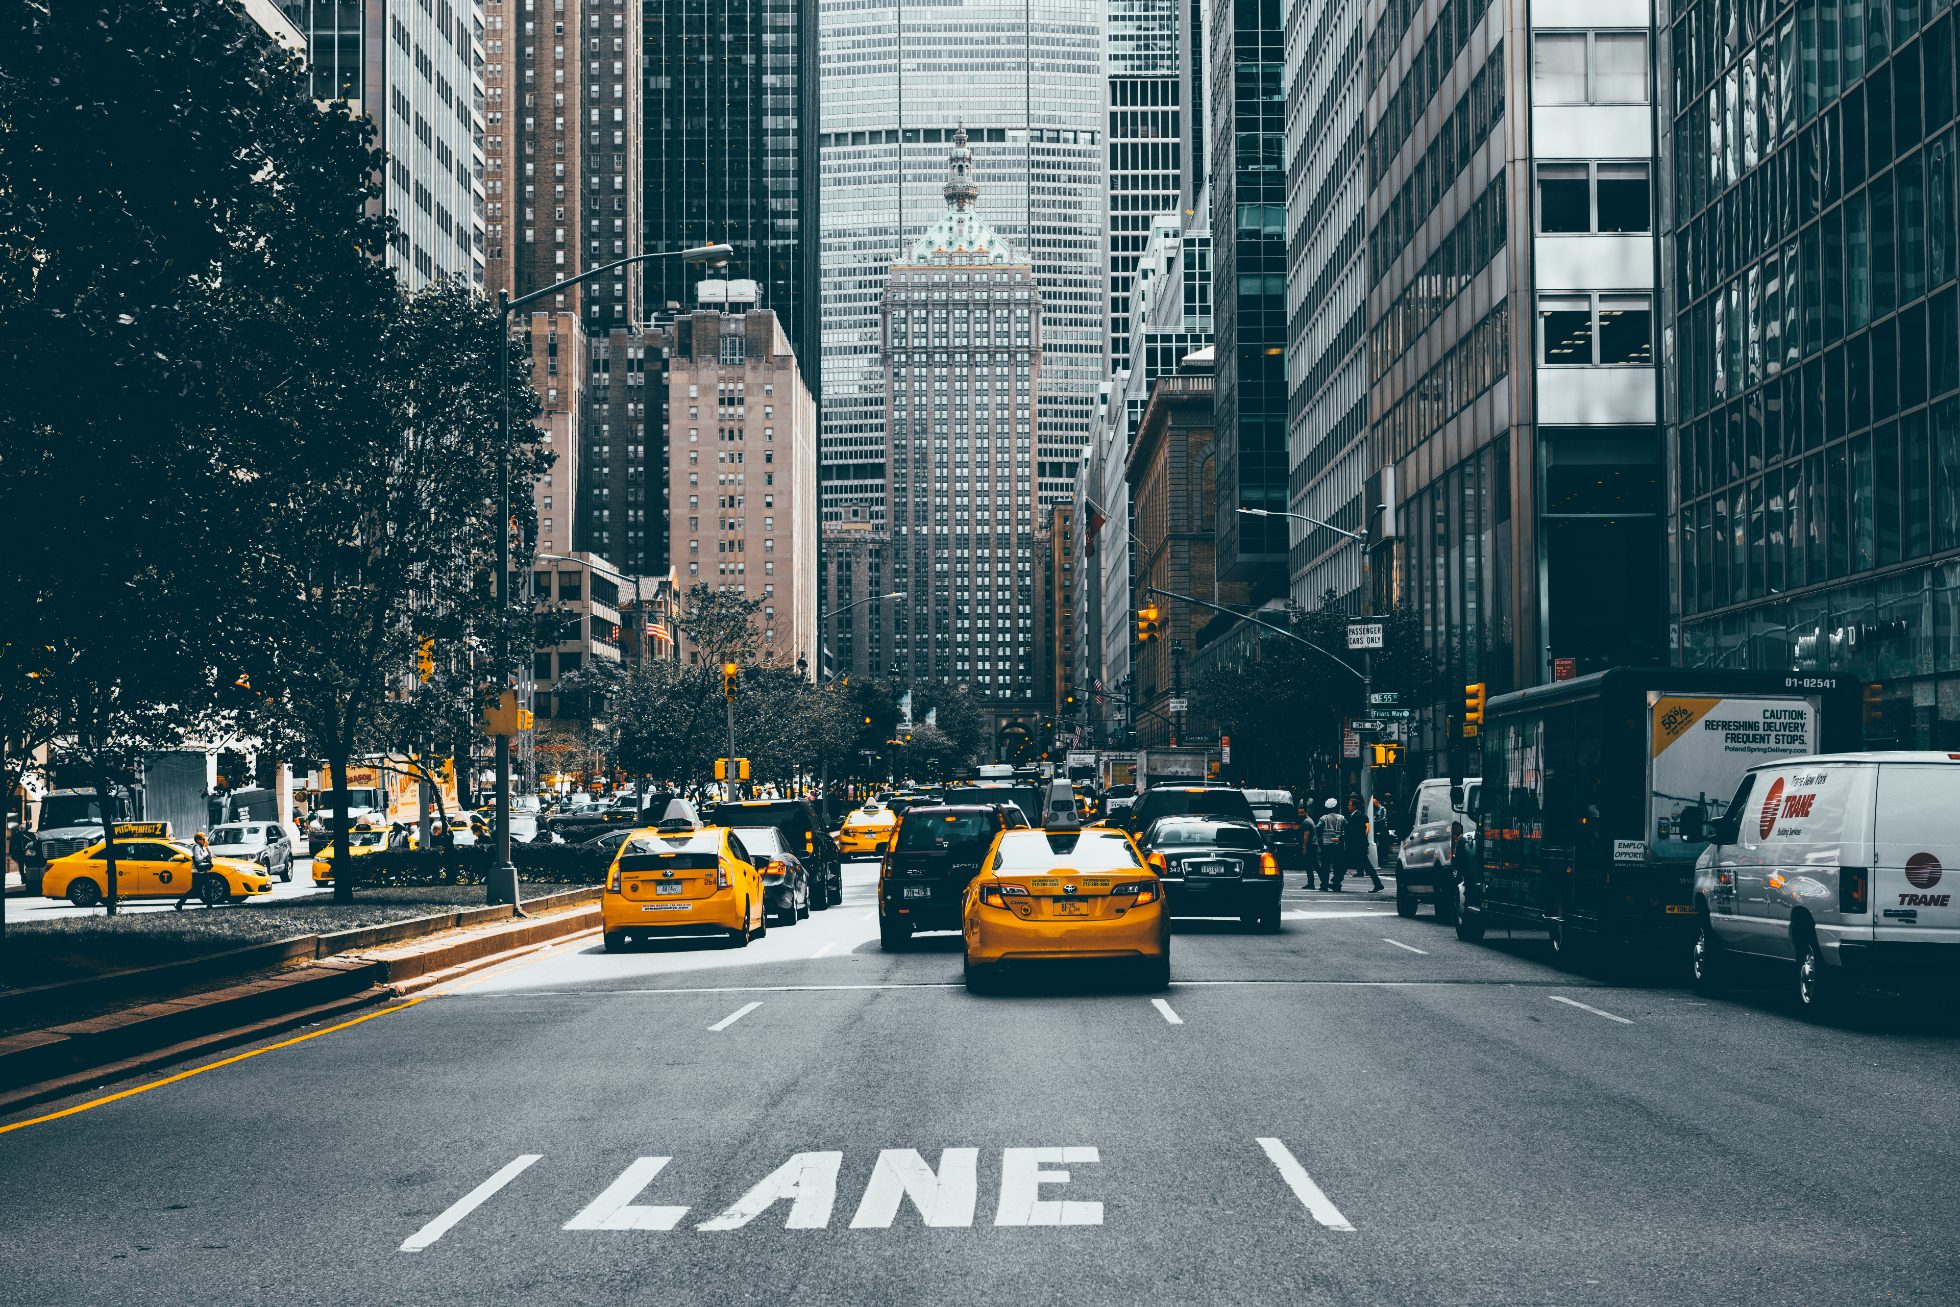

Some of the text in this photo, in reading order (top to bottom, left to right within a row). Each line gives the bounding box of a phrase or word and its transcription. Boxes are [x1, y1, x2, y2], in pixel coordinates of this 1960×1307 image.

[1349, 627, 1382, 636] PASSENGER
[1350, 636, 1380, 645] CARS ONLY
[1785, 677, 1836, 689] 01-02541
[1383, 694, 1392, 702] 55
[1391, 710, 1403, 718] Way
[1661, 706, 1688, 730] 50%
[1762, 709, 1807, 720] CAUTION:
[1704, 720, 1760, 732] REFRESHING
[1762, 721, 1807, 733] DELIVERY.
[1725, 732, 1807, 745] FREQUENT STOPS.
[1781, 794, 1816, 818] TRANE
[114, 823, 162, 835] PITCH PERFECT 2
[1899, 893, 1951, 907] TRANE
[561, 1146, 1105, 1231] LANE
